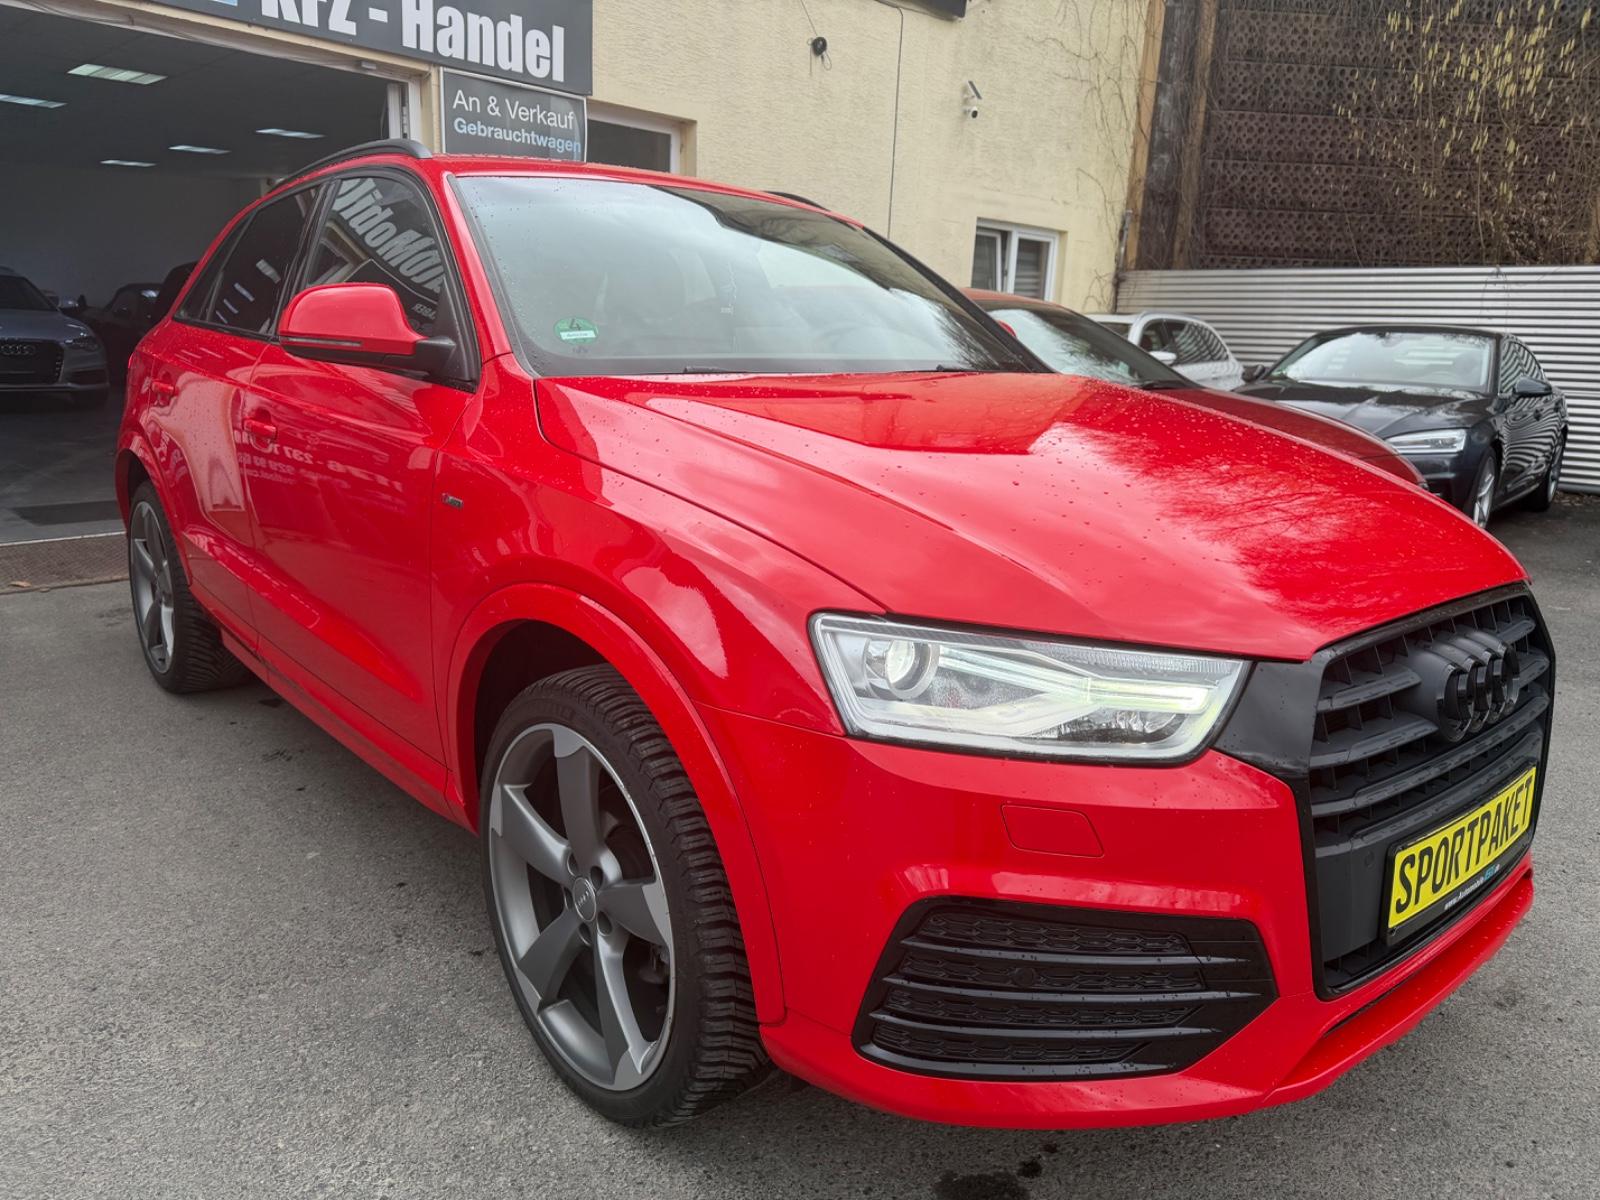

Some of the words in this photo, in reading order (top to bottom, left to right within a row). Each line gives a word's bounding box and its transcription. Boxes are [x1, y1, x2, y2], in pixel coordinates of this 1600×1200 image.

[401, 0, 565, 82] Handel
[453, 90, 480, 112] An
[487, 96, 501, 117] &
[505, 98, 575, 129] Verkauf
[454, 117, 581, 153] Gebrauchtwagen
[569, 318, 581, 331] 4
[1395, 776, 1533, 914] SPORTPAKET
